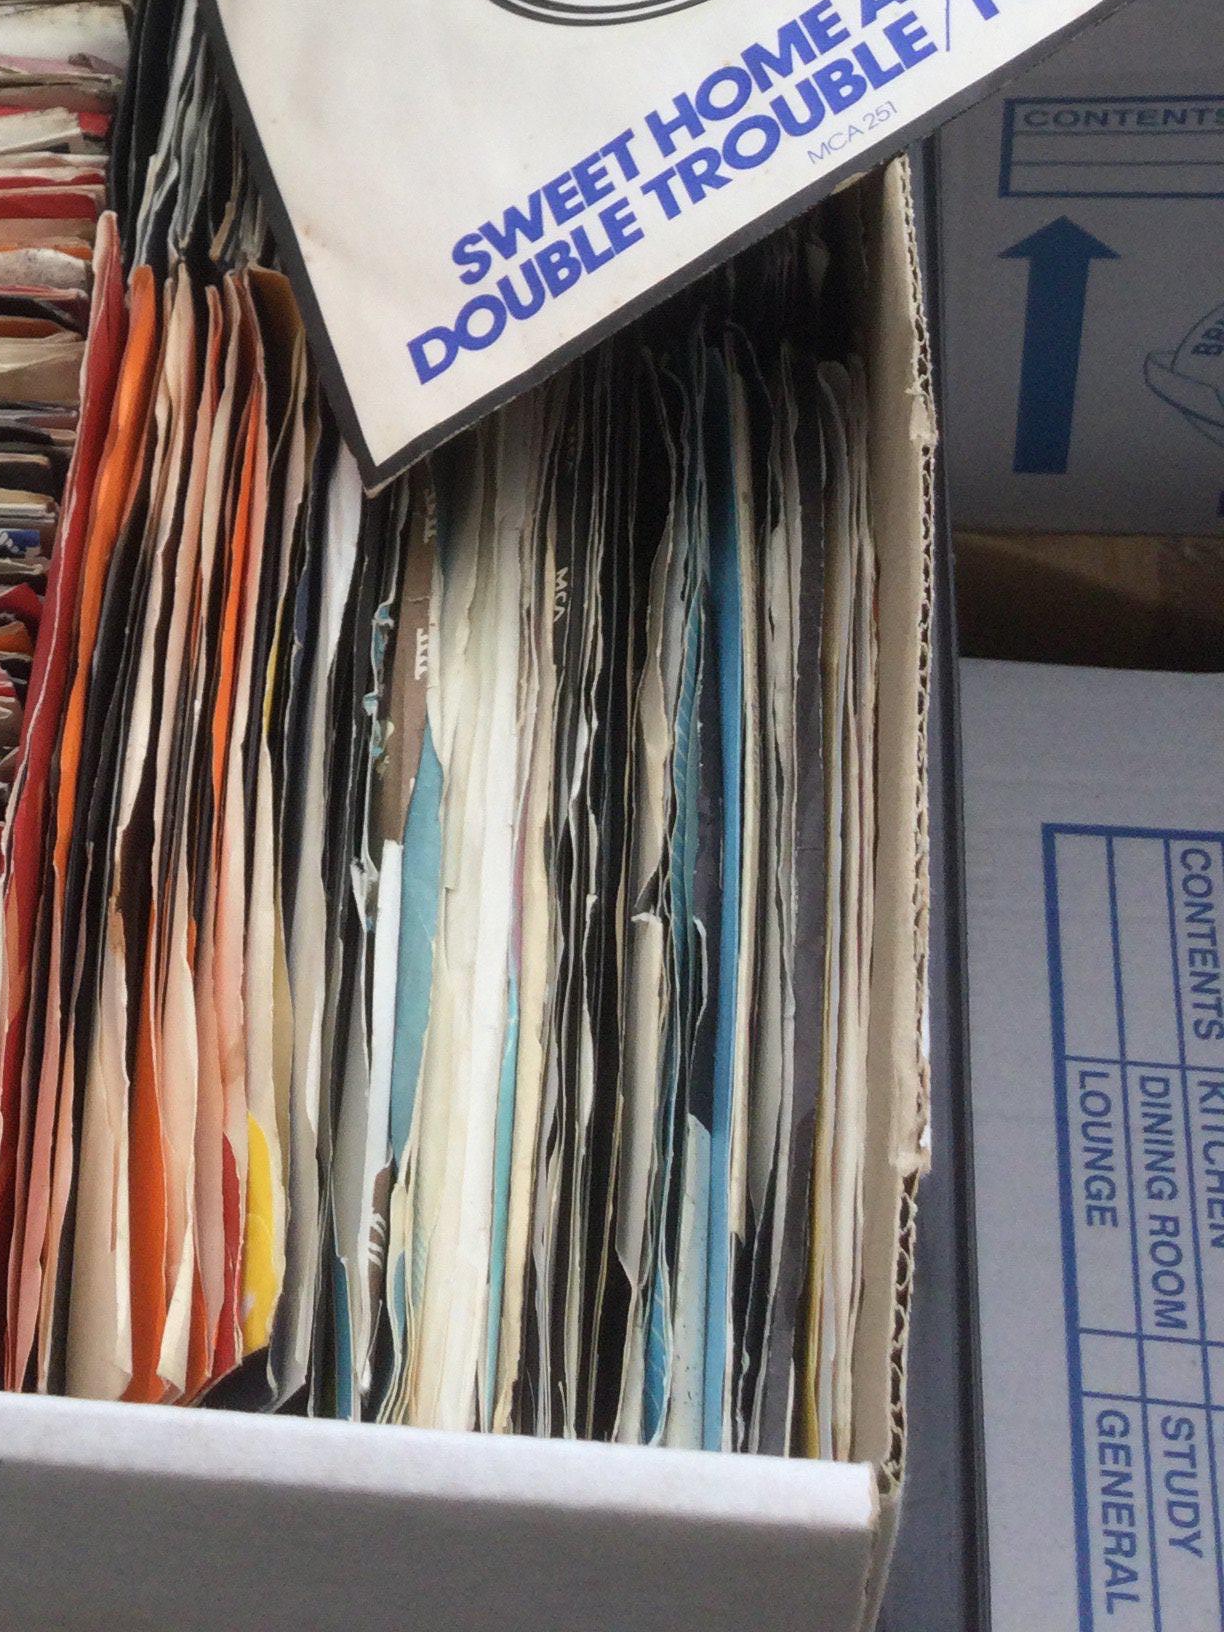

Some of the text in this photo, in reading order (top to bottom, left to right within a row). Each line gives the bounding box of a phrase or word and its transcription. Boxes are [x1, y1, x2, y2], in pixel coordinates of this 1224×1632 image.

[452, 130, 639, 285] SWEET
[646, 0, 850, 157] HOME
[806, 100, 898, 166] MCA 251
[408, 168, 681, 384] DOUBLE
[1179, 847, 1224, 1041] CONTENTS
[1078, 1069, 1119, 1229] LOUNGE
[1138, 1074, 1188, 1331] DINING ROOM
[1096, 1409, 1141, 1616] GENERAL
[1161, 1415, 1204, 1559] STUDY
